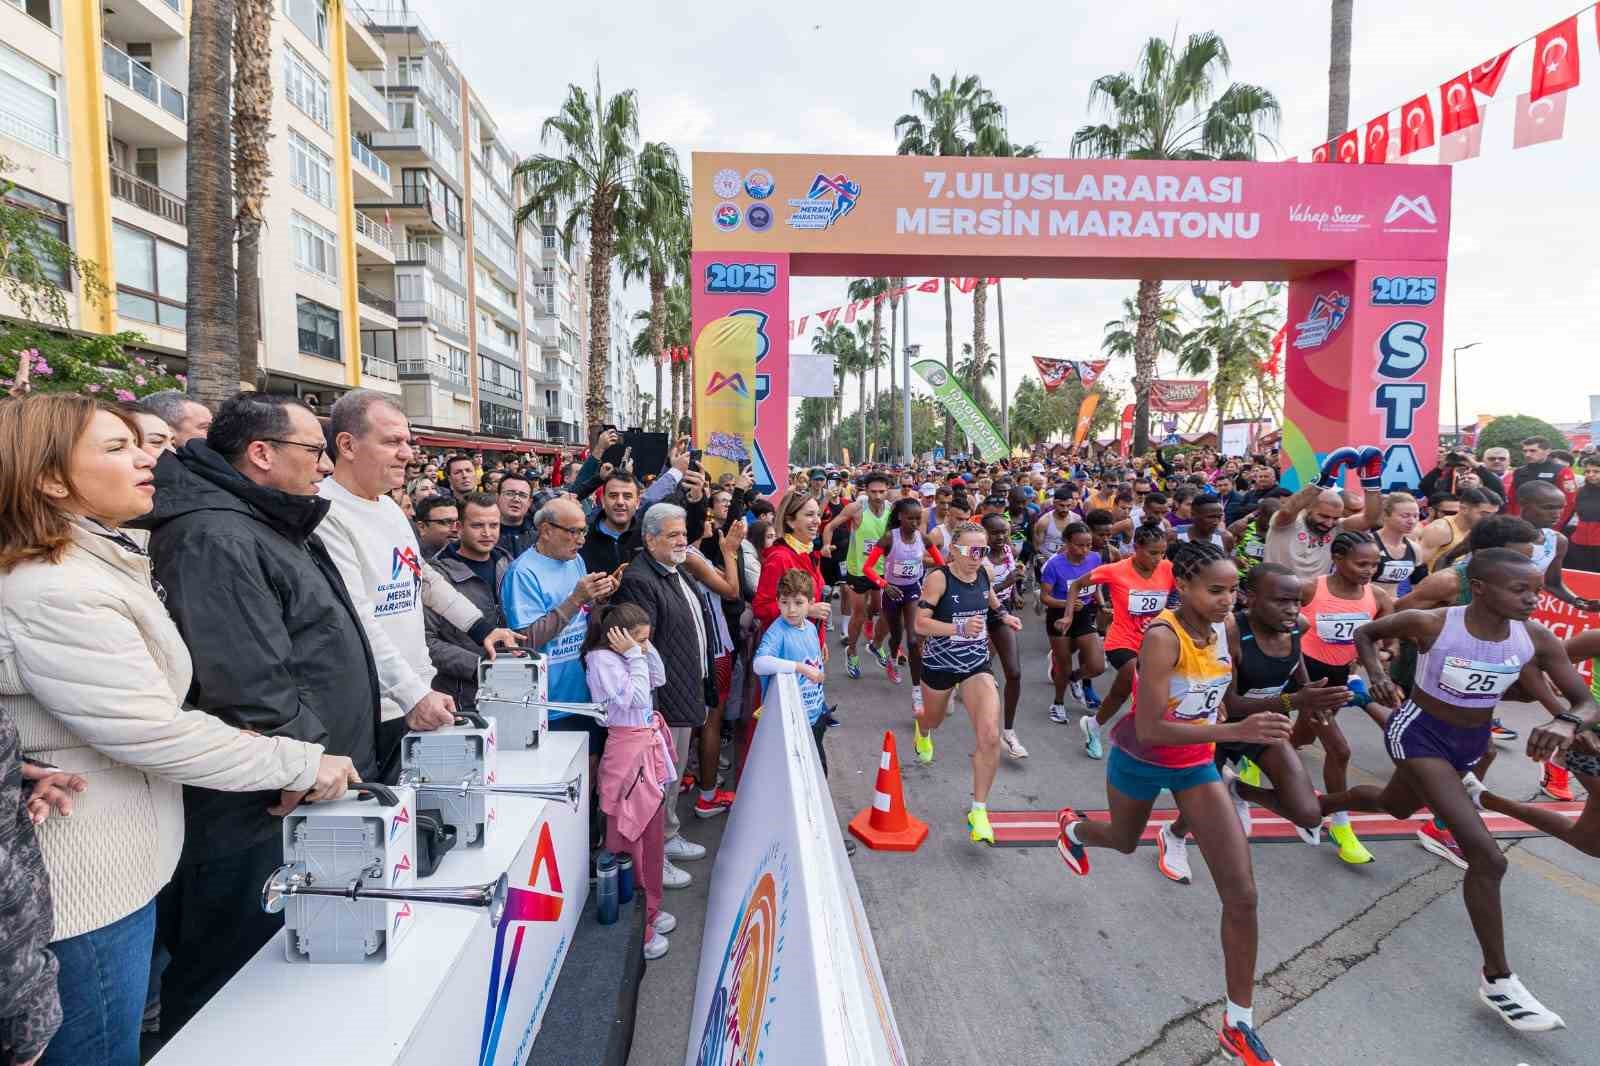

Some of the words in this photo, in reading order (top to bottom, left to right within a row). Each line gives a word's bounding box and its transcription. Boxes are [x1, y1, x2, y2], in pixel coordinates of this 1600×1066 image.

[923, 171, 1242, 204] 7.ULUSLARARASI
[896, 200, 1040, 236] MERSİN
[1048, 208, 1260, 240] MARATONU
[1289, 203, 1328, 231] Vahap
[707, 263, 776, 293] 2025
[1373, 276, 1437, 305] 2025
[1141, 597, 1158, 611] 28
[1334, 622, 1355, 638] 27
[1465, 673, 1499, 692] 25
